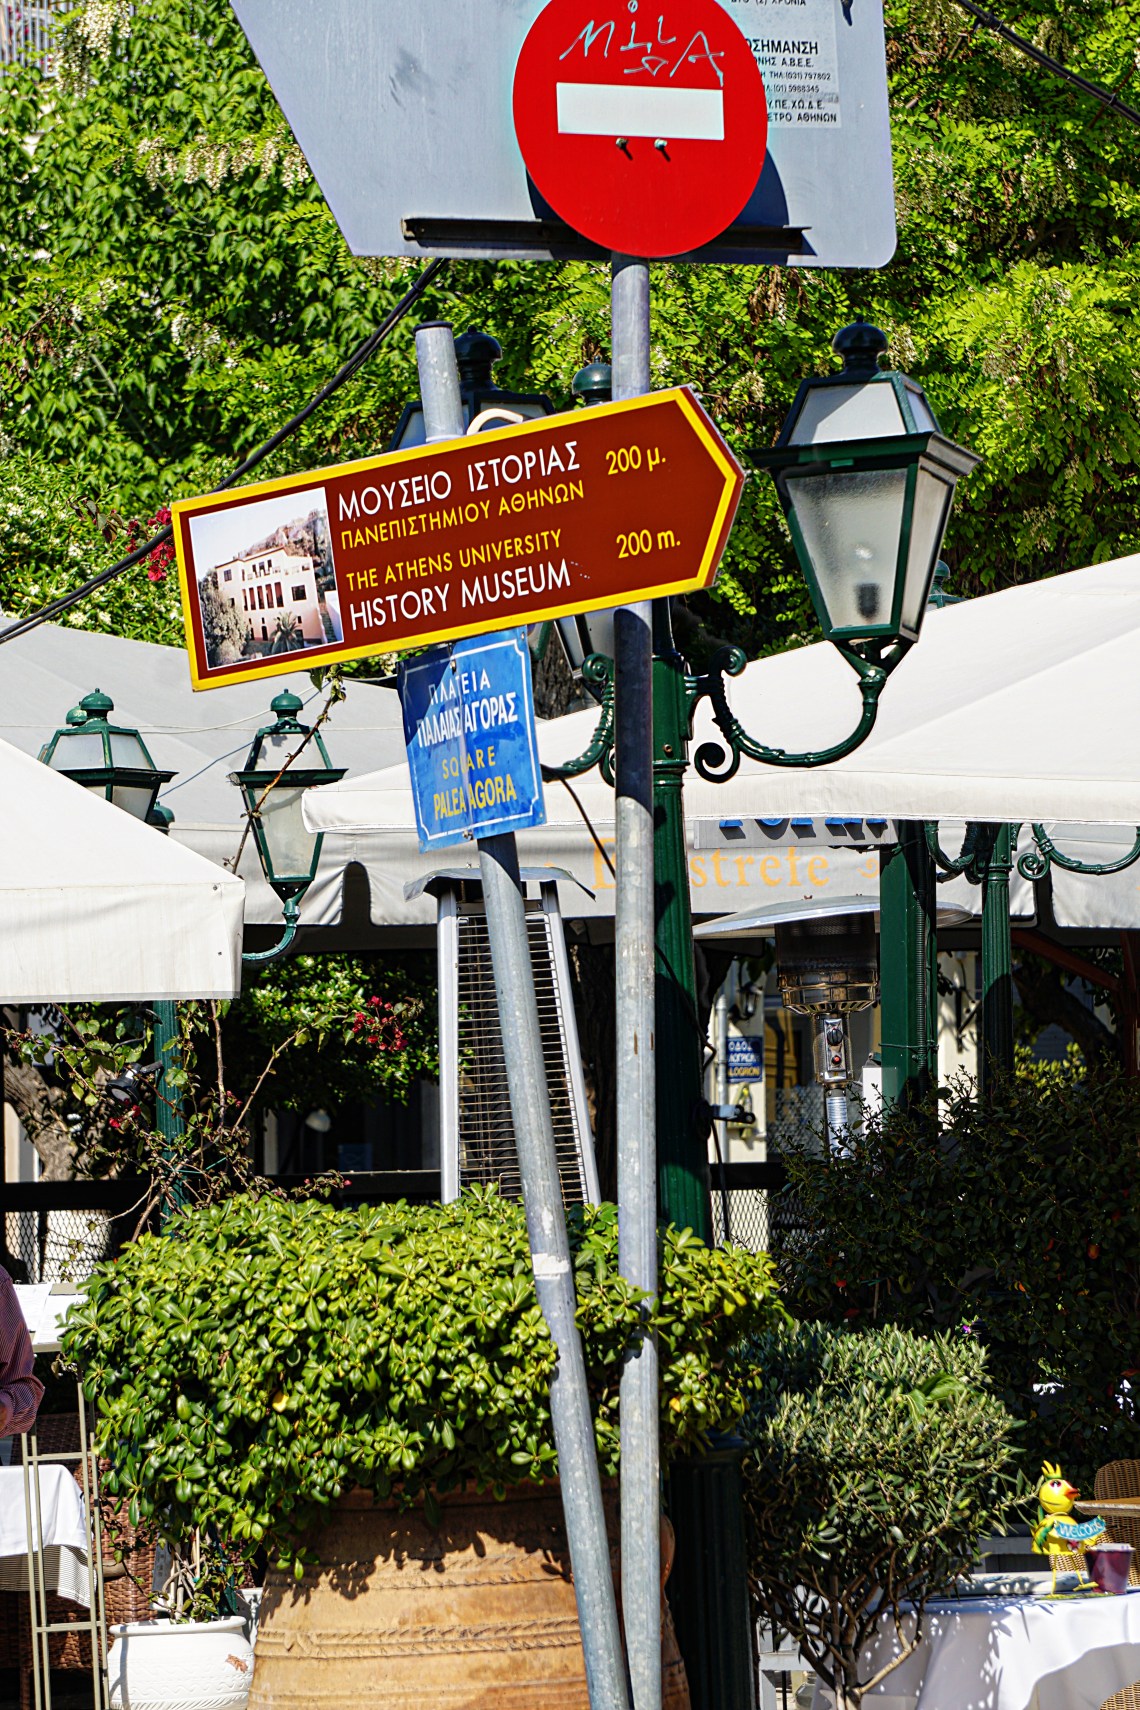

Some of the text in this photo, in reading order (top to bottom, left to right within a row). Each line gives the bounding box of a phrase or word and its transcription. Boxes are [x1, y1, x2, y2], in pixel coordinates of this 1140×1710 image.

[755, 57, 777, 66] ΝΗΣ
[797, 112, 837, 123] ΑΘΗΝΩΝ
[338, 440, 581, 522] ΜΟΥΣΕΙΟ ΙΣΤΟΡΙΑΣ
[605, 445, 642, 476] 200
[341, 479, 585, 551] ΠΑΝΕΠΙΣΤΗΜΙΟΥ ΑΘΗΝΩΝ
[346, 528, 562, 592] THE ATHENS UNIVERSITY
[616, 529, 681, 559] 200 m.
[350, 557, 572, 631] HISTORY MUSEUM
[428, 667, 491, 706] ΠΛΑΤΕΙΑ
[464, 691, 518, 733] ΑΓΟΡΑΣ
[433, 773, 518, 821] PALEA AGORA
